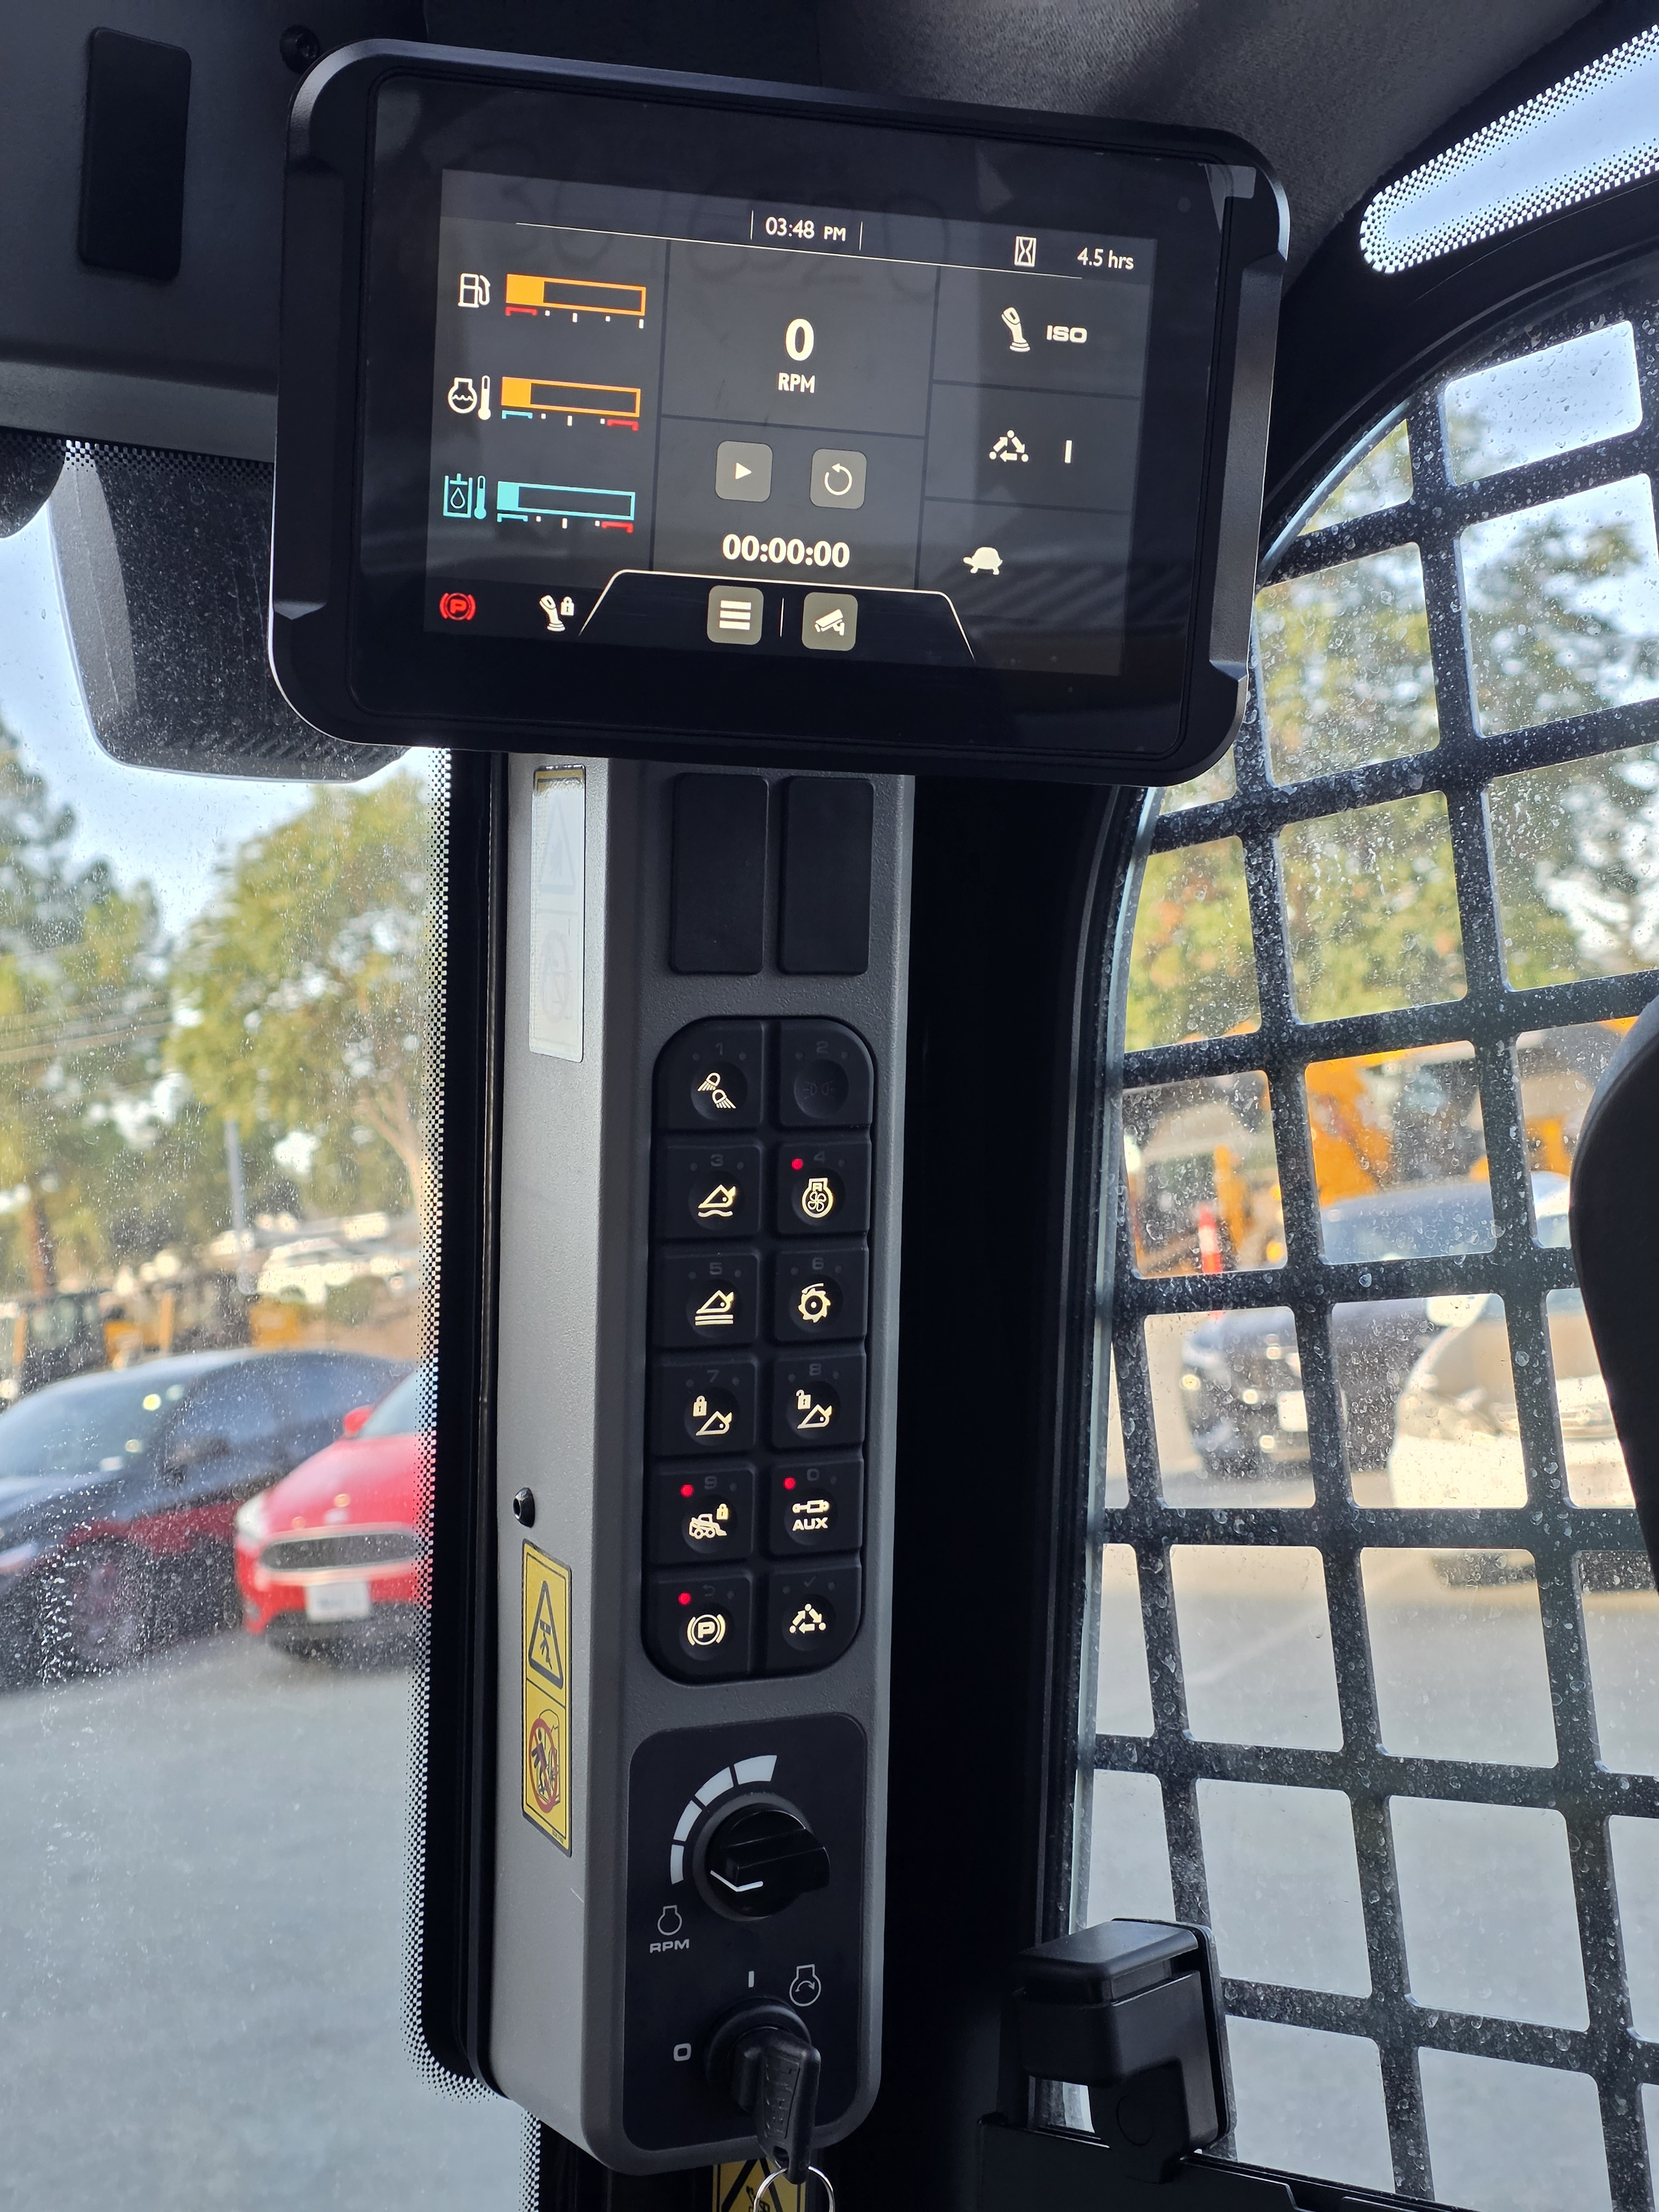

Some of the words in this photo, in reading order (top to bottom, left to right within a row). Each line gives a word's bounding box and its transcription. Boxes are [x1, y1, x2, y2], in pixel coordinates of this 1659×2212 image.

[765, 217, 815, 239] 03:48
[824, 226, 846, 241] PM
[1077, 247, 1103, 267] 4.5
[1108, 249, 1134, 270] hrs
[786, 319, 814, 361] 0
[1046, 325, 1087, 344] ISO
[778, 372, 815, 393] RPM
[722, 534, 850, 568] 00:00:00
[716, 1042, 724, 1055] 1
[816, 1041, 828, 1055] 2
[711, 1154, 724, 1167] 3
[813, 1151, 826, 1164] 4
[709, 1262, 723, 1275] 5
[812, 1257, 825, 1270] 6
[707, 1370, 720, 1383] 7
[809, 1363, 822, 1376] 8
[792, 1517, 828, 1531] AUX
[697, 1621, 715, 1639] P
[649, 1939, 690, 1953] RPM
